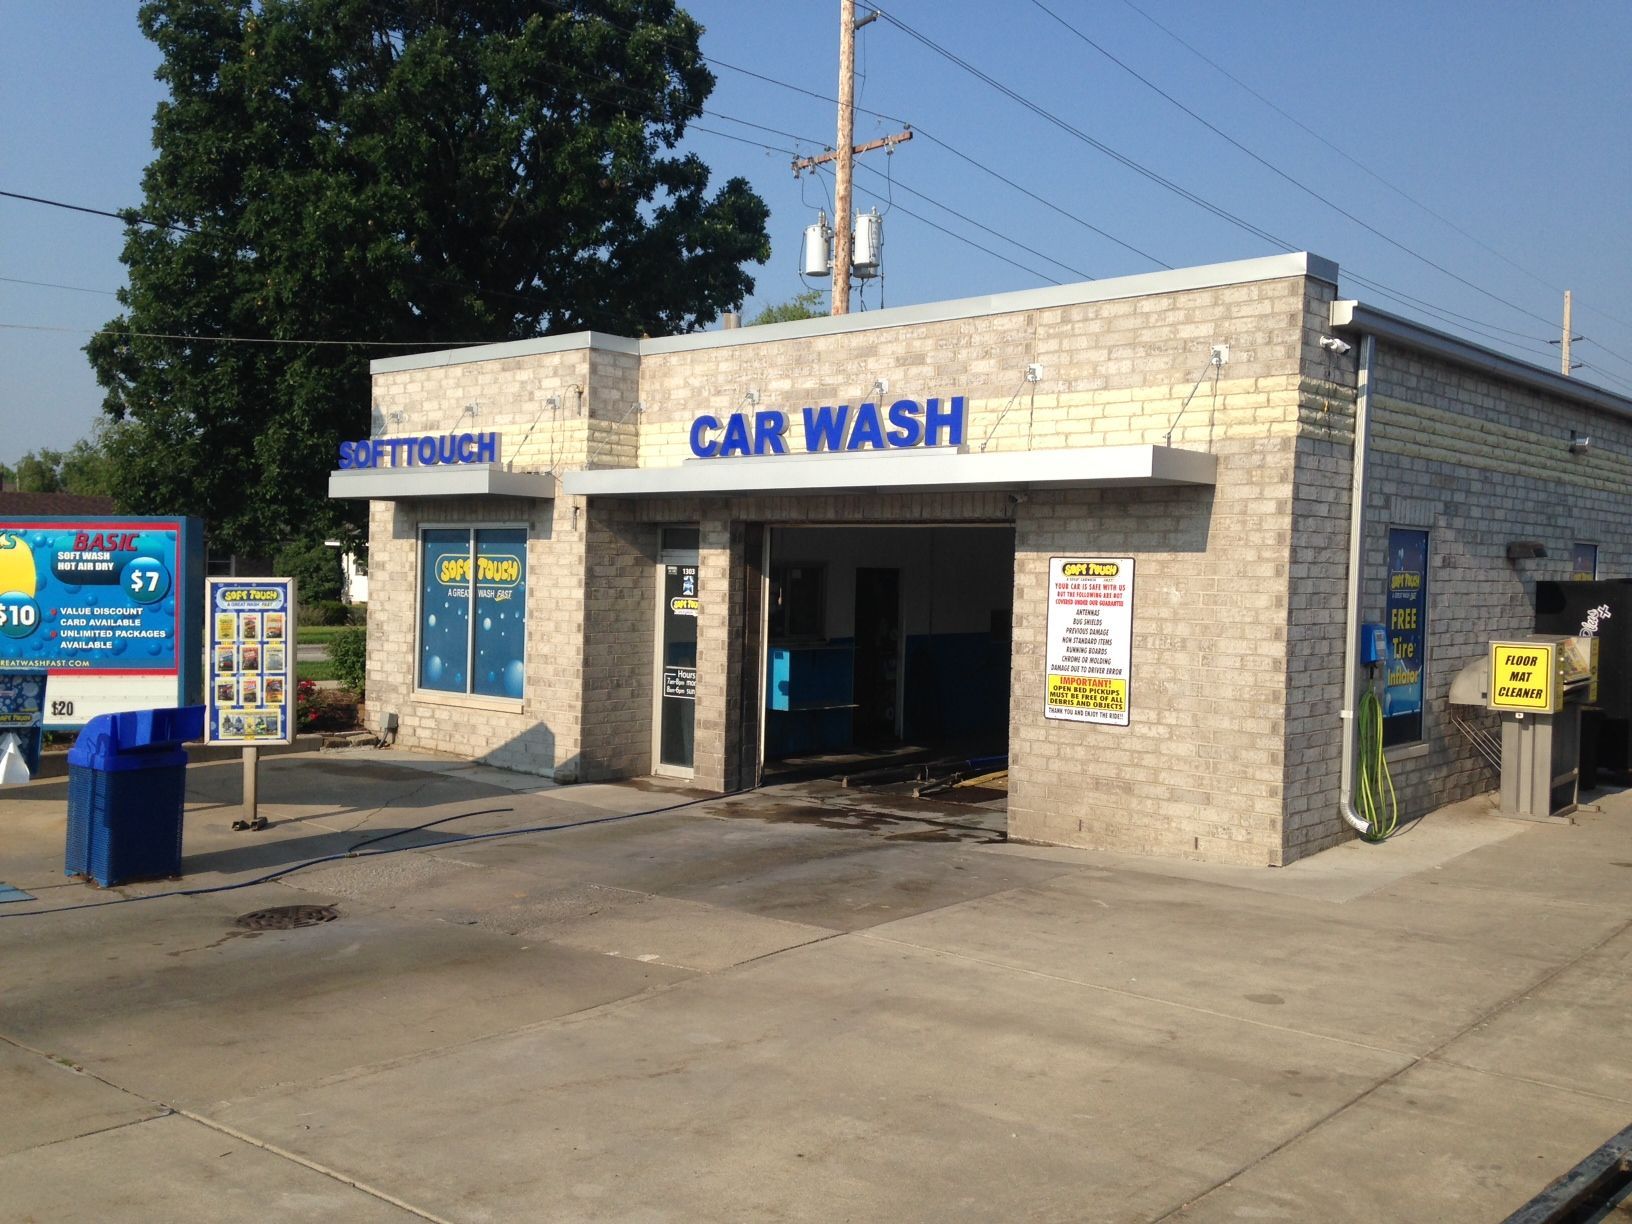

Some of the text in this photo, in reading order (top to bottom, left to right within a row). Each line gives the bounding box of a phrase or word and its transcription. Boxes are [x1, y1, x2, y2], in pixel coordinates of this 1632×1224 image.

[690, 396, 968, 458] CAR WASH
[73, 532, 140, 552] BASIC
[57, 552, 110, 560] SOFT WASH
[57, 562, 115, 571] HOT AIR DRY
[441, 557, 518, 582] SOFT TOUCH
[131, 569, 160, 592] $7
[447, 588, 452, 597] A
[478, 589, 495, 598] WASH
[1103, 584, 1117, 592] WITH
[225, 590, 278, 601] SOFT TOUCH
[0, 603, 35, 626] $10
[1391, 608, 1417, 630] FREE
[1073, 617, 1103, 626] BUG SHIELDS
[60, 630, 166, 638] UNLIMITED PACKAGES
[1065, 627, 1109, 636] PREVIOUS DAMAGE
[60, 641, 113, 649] AVAILABLE
[1073, 637, 1098, 645] STANDARD
[1098, 638, 1113, 646] ITEMS
[1066, 646, 1108, 655] RUNNING BOARDS
[1392, 637, 1414, 659] Tire
[1061, 655, 1081, 663] CHROME
[1089, 657, 1112, 665] MOLDING
[1505, 655, 1539, 667] FLOOR
[677, 670, 696, 680] Hours
[1051, 664, 1070, 672] DAMAGE
[1070, 665, 1081, 673] DUE
[1088, 666, 1106, 674] DRIVER
[1106, 667, 1123, 676] ERROR
[1060, 676, 1112, 689] IMPORTANT!
[1388, 667, 1420, 686] Inflator
[1509, 671, 1533, 683] MAT
[1053, 684, 1121, 697] OPEN BED PICKUPS
[1497, 686, 1543, 700] CLEANER
[1049, 691, 1124, 704] MUST BE FREE OF ALL
[51, 700, 75, 717] $20
[1049, 697, 1075, 706] DEBRIS
[1092, 701, 1124, 711] OBJECTS
[1048, 707, 1064, 715] THANK
[1064, 708, 1074, 716] YOU
[1074, 709, 1085, 717] AND
[1085, 710, 1099, 718] ENJOY
[1099, 711, 1109, 719] THE
